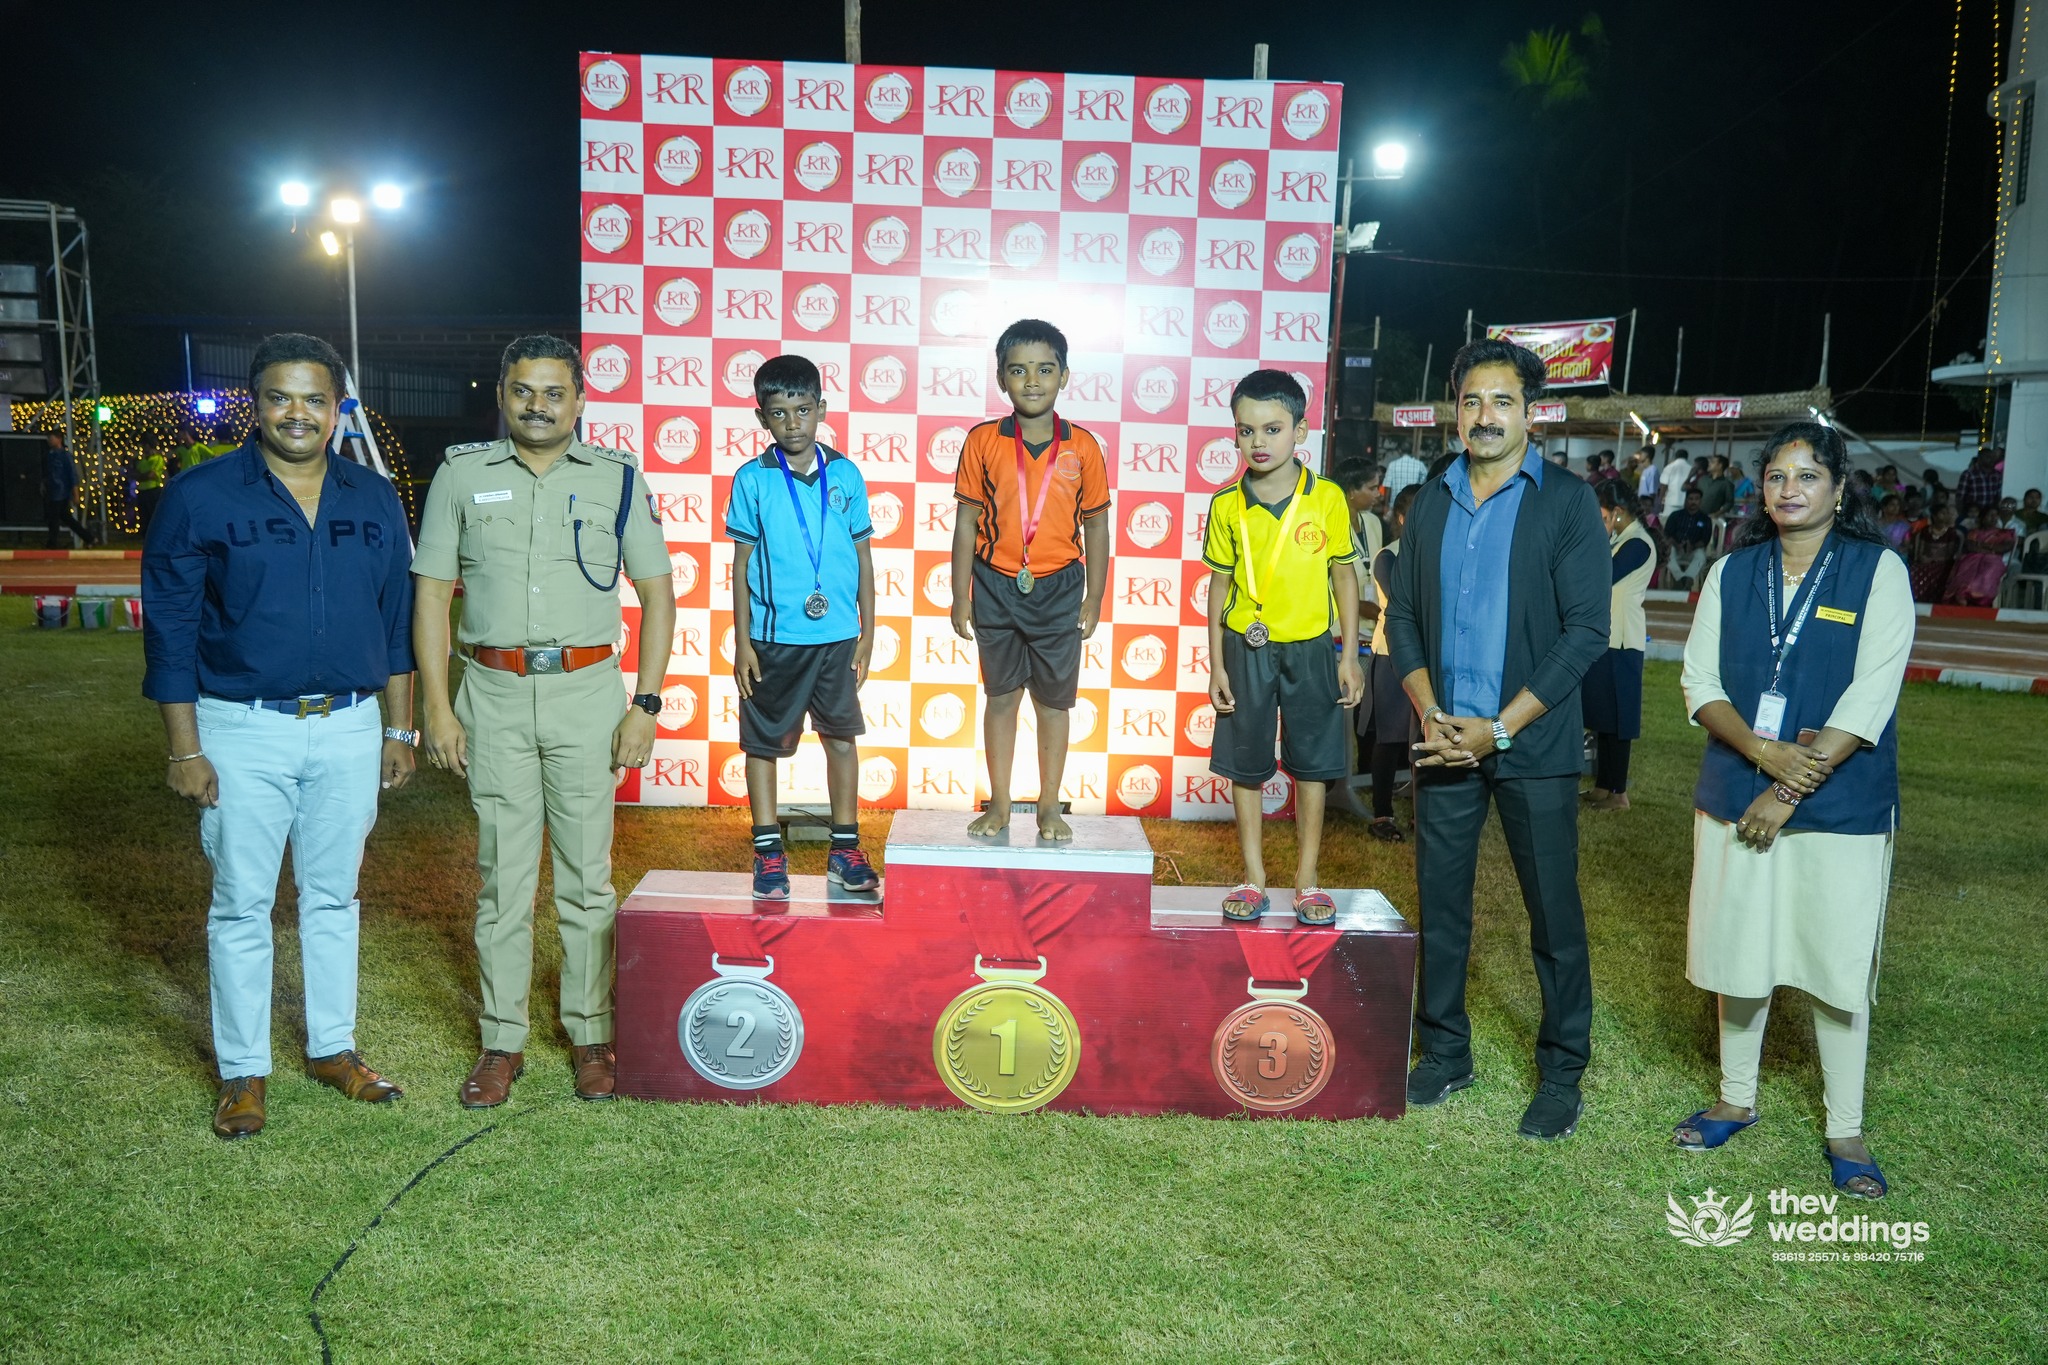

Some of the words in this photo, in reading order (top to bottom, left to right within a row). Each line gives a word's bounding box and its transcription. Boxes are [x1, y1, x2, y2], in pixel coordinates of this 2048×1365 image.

[647, 72, 710, 105] RR
[788, 78, 851, 111] RR
[928, 84, 991, 117] RR
[1068, 90, 1130, 123] RR
[1206, 96, 1268, 129] RR
[582, 141, 639, 174] RR
[718, 147, 780, 180] RR
[857, 153, 919, 185] RR
[996, 158, 1058, 191] RR
[1134, 164, 1196, 197] RR
[1271, 170, 1333, 203] RR
[648, 215, 709, 248] RR
[787, 221, 848, 253] RR
[925, 226, 987, 259] RR
[1200, 238, 1261, 270] RR
[582, 283, 639, 315] RR
[717, 288, 778, 320] RR
[855, 294, 916, 326] RR
[1264, 311, 1325, 342] RR
[817, 362, 845, 392] R
[1194, 377, 1240, 408] R
[1396, 409, 1434, 423] CASHIER
[919, 502, 957, 532] R
[874, 567, 907, 596] R
[726, 1010, 756, 1058] 2
[990, 1019, 1017, 1076] 1
[1258, 1031, 1288, 1080] 3
